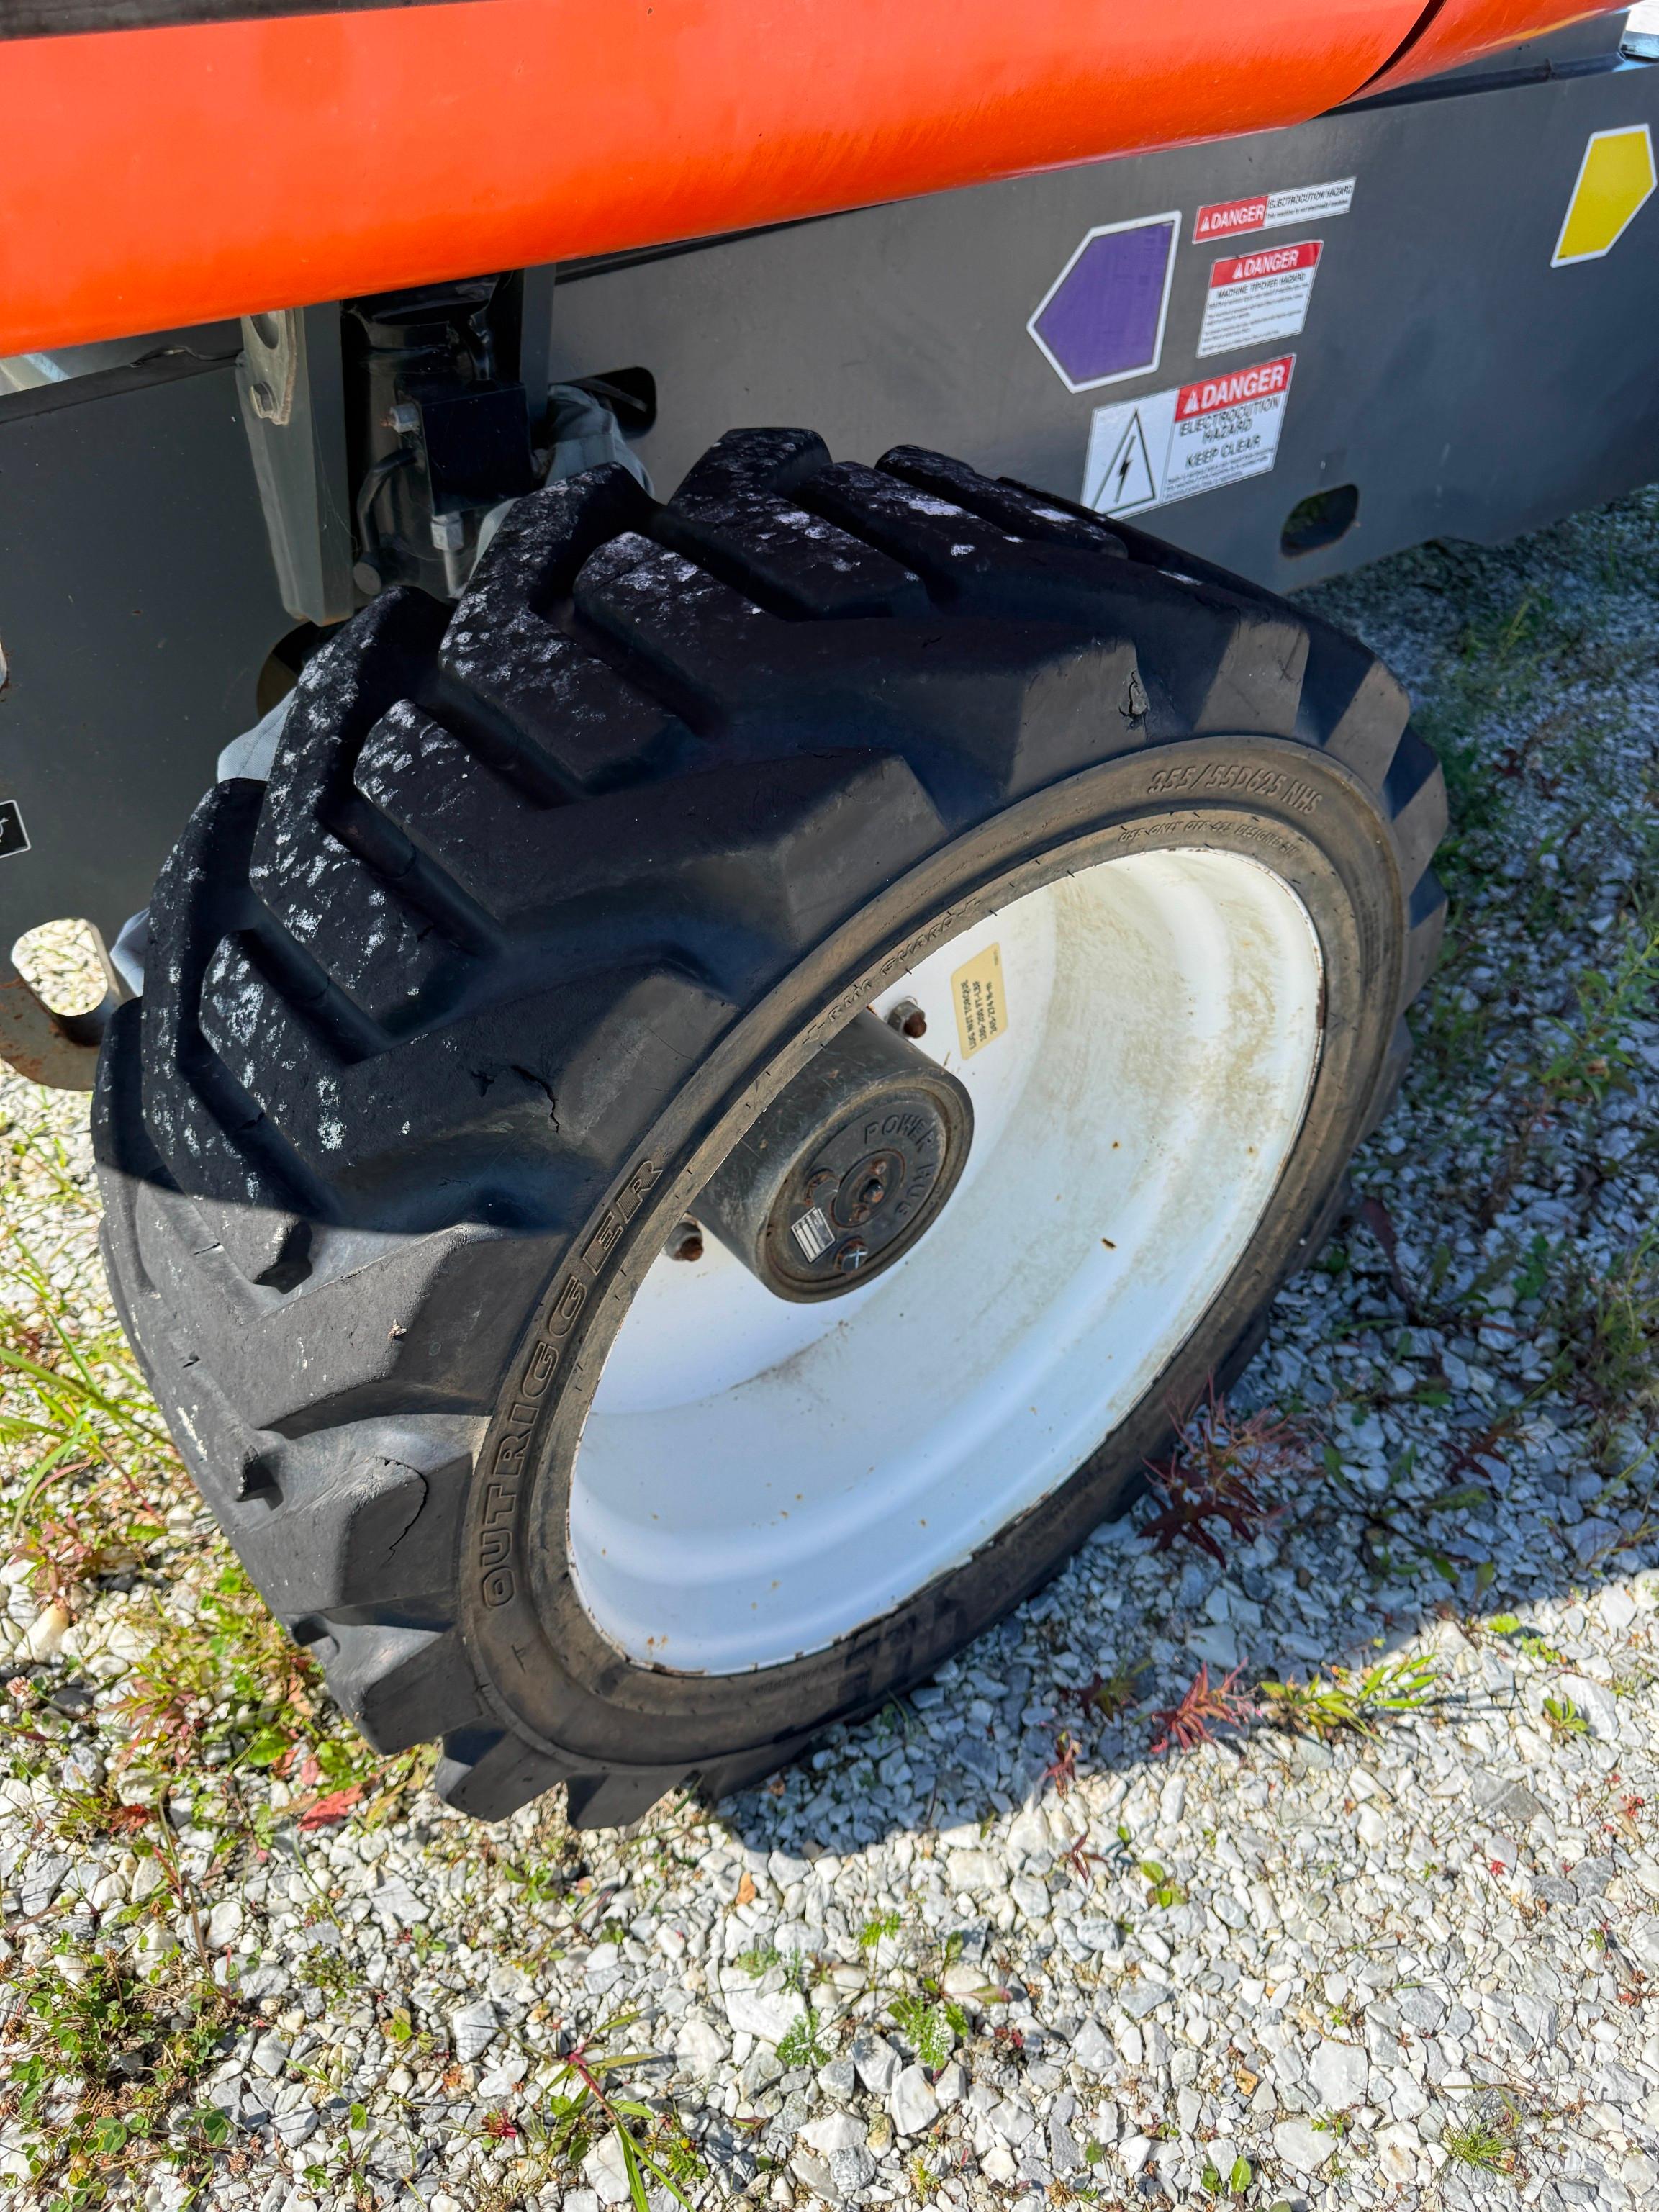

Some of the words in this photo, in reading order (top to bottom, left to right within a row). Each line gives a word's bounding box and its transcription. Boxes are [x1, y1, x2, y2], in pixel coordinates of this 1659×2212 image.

[1270, 191, 1324, 209] ELECTROCUTION
[1326, 184, 1353, 198] HAZARD
[1211, 204, 1265, 230] DANGER
[1244, 249, 1299, 276] DANGER
[1218, 284, 1248, 299] MACHINE
[1280, 272, 1306, 286] HAZARD
[1201, 364, 1285, 409] DANGER
[1180, 397, 1279, 437] ELECTROCUTION
[1202, 418, 1252, 444] HAZARD
[1186, 446, 1218, 469] KEEP
[1221, 434, 1260, 458] CLEAR
[1281, 780, 1323, 815] NHS
[961, 979, 971, 1015] TORQUE
[864, 1113, 936, 1152] POWER
[895, 1163, 935, 1216] HUB
[481, 1160, 663, 1609] OUTRIGGER
